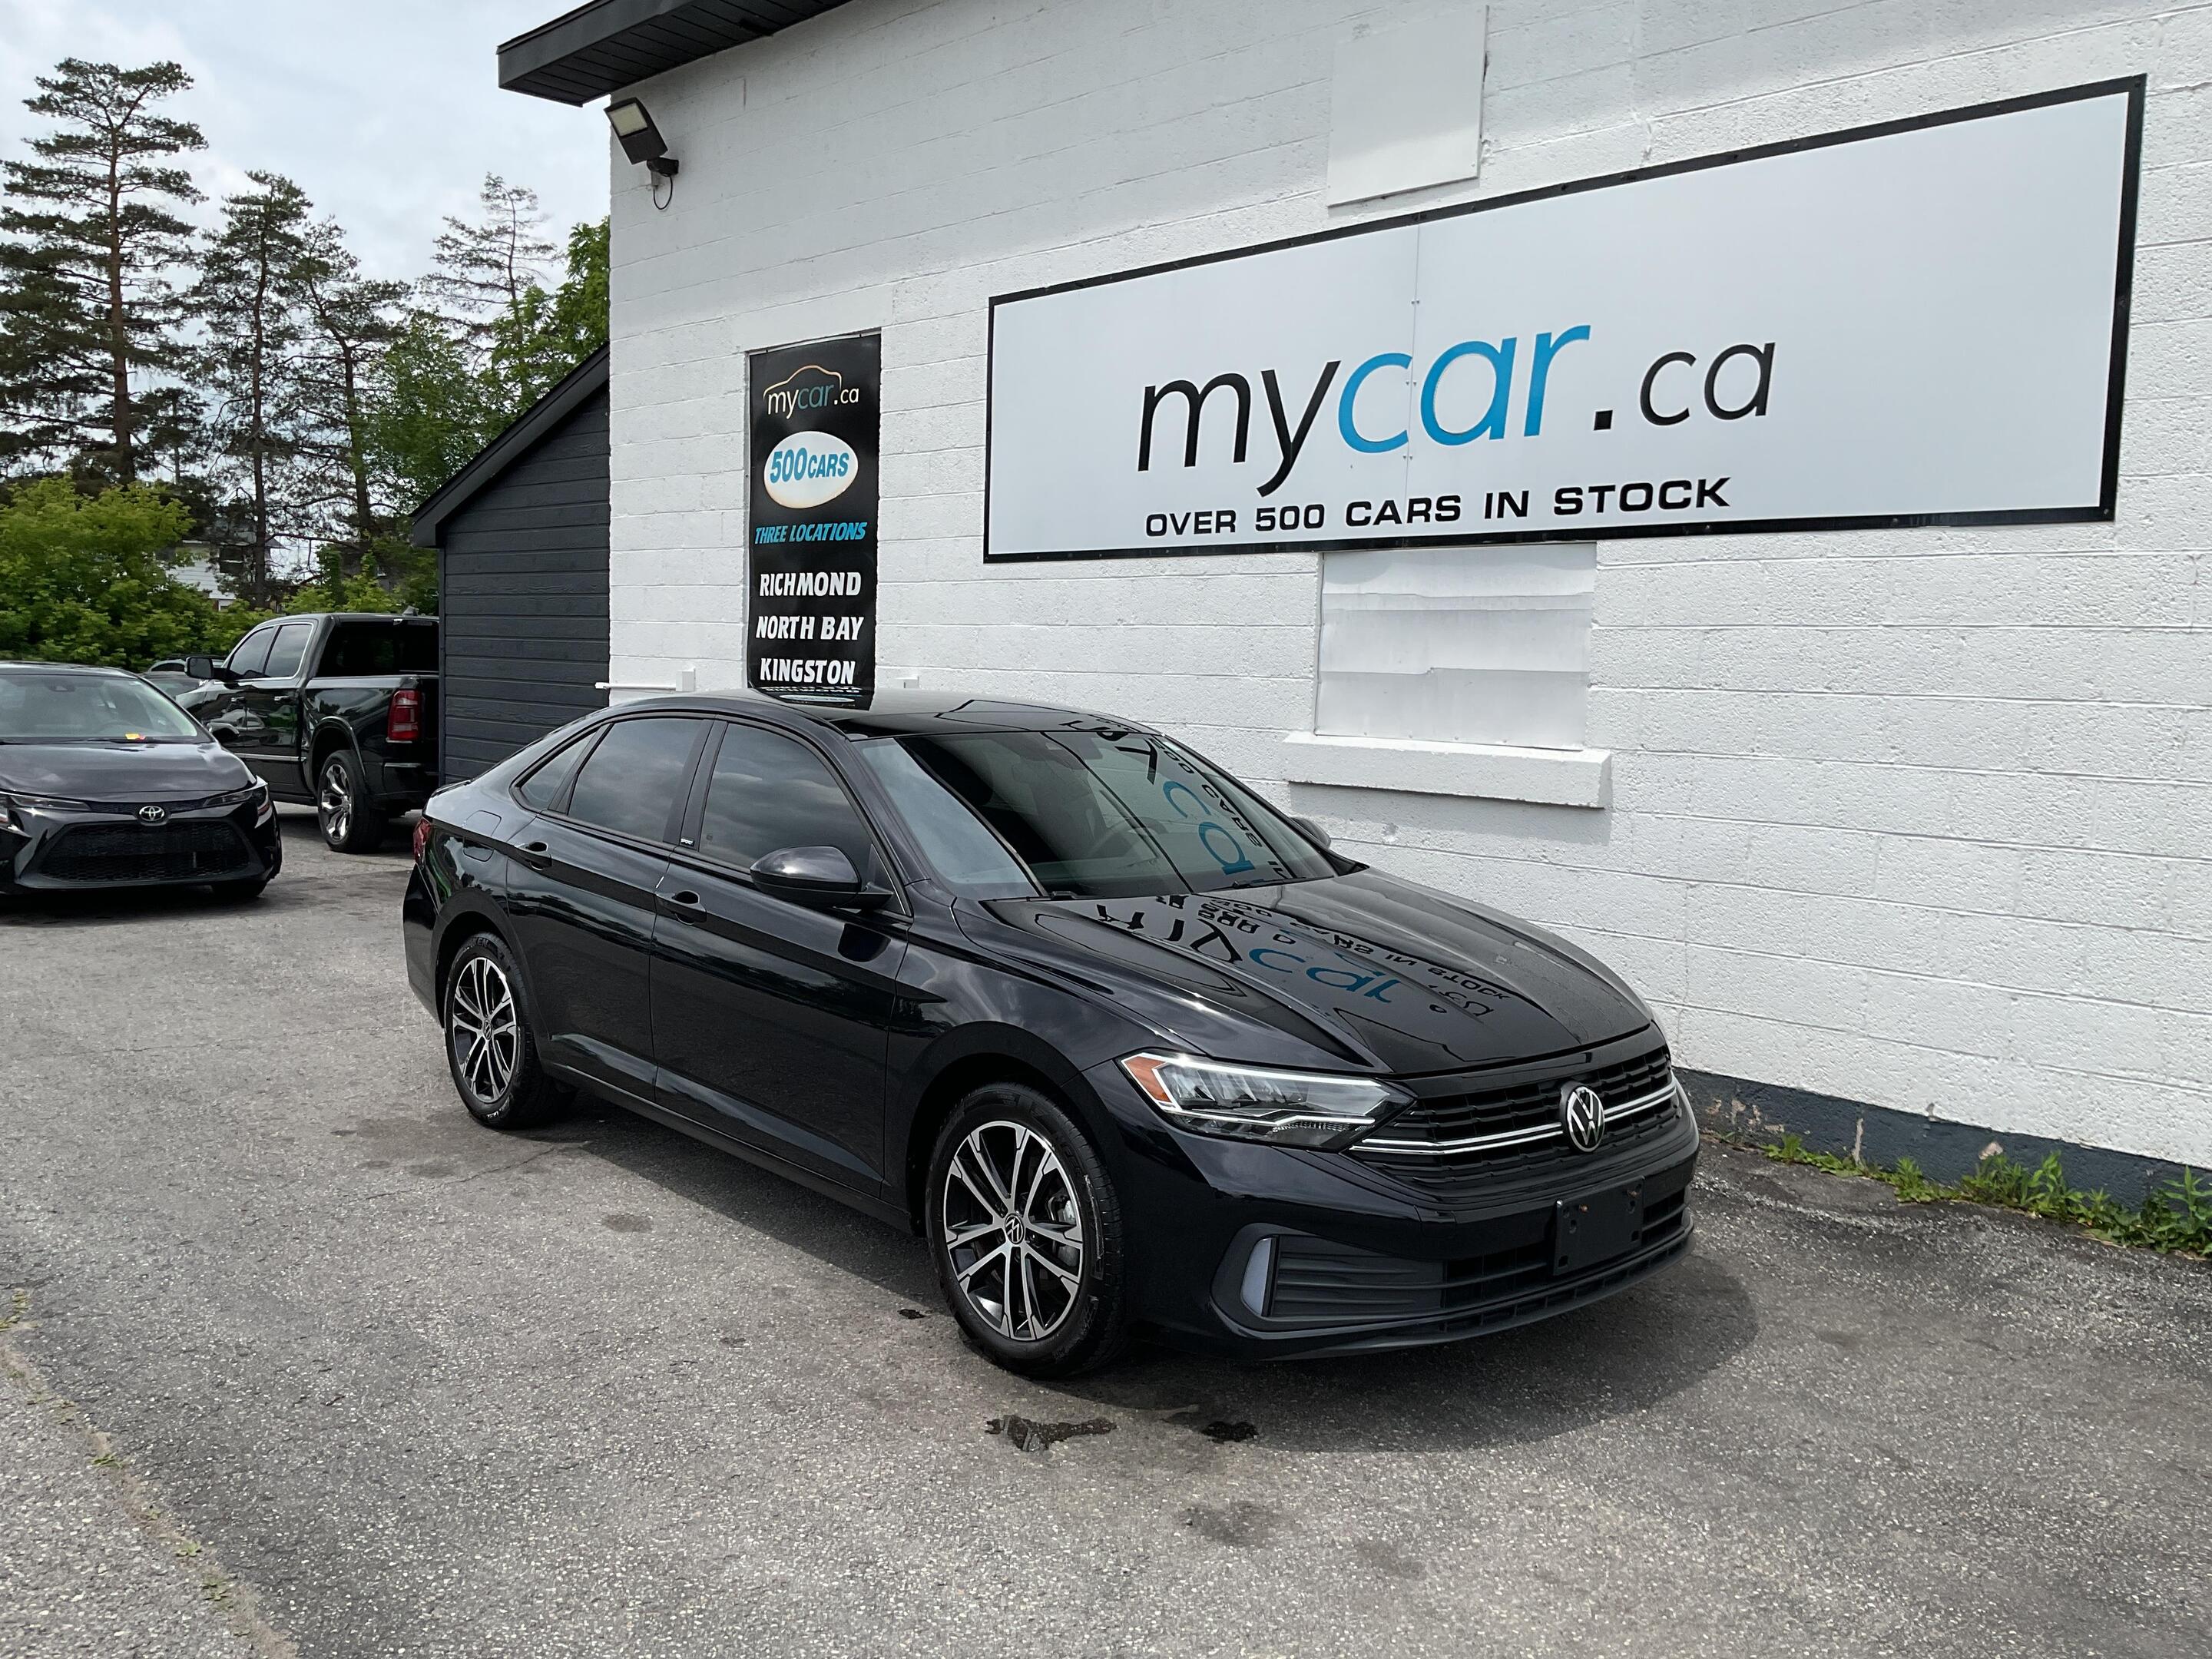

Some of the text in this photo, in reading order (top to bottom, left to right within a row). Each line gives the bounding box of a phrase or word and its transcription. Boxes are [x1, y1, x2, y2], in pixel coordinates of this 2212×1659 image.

[767, 385, 859, 419] mycar.ca
[1137, 324, 1776, 497] mycar.ca
[1146, 477, 1732, 537] OVER 500 CARS IN STOCK
[754, 522, 868, 545] THREE LOCATIONS
[759, 571, 862, 597] RICHMOND
[755, 615, 865, 641] NORTH BAY
[760, 657, 856, 685] KINGSTON
